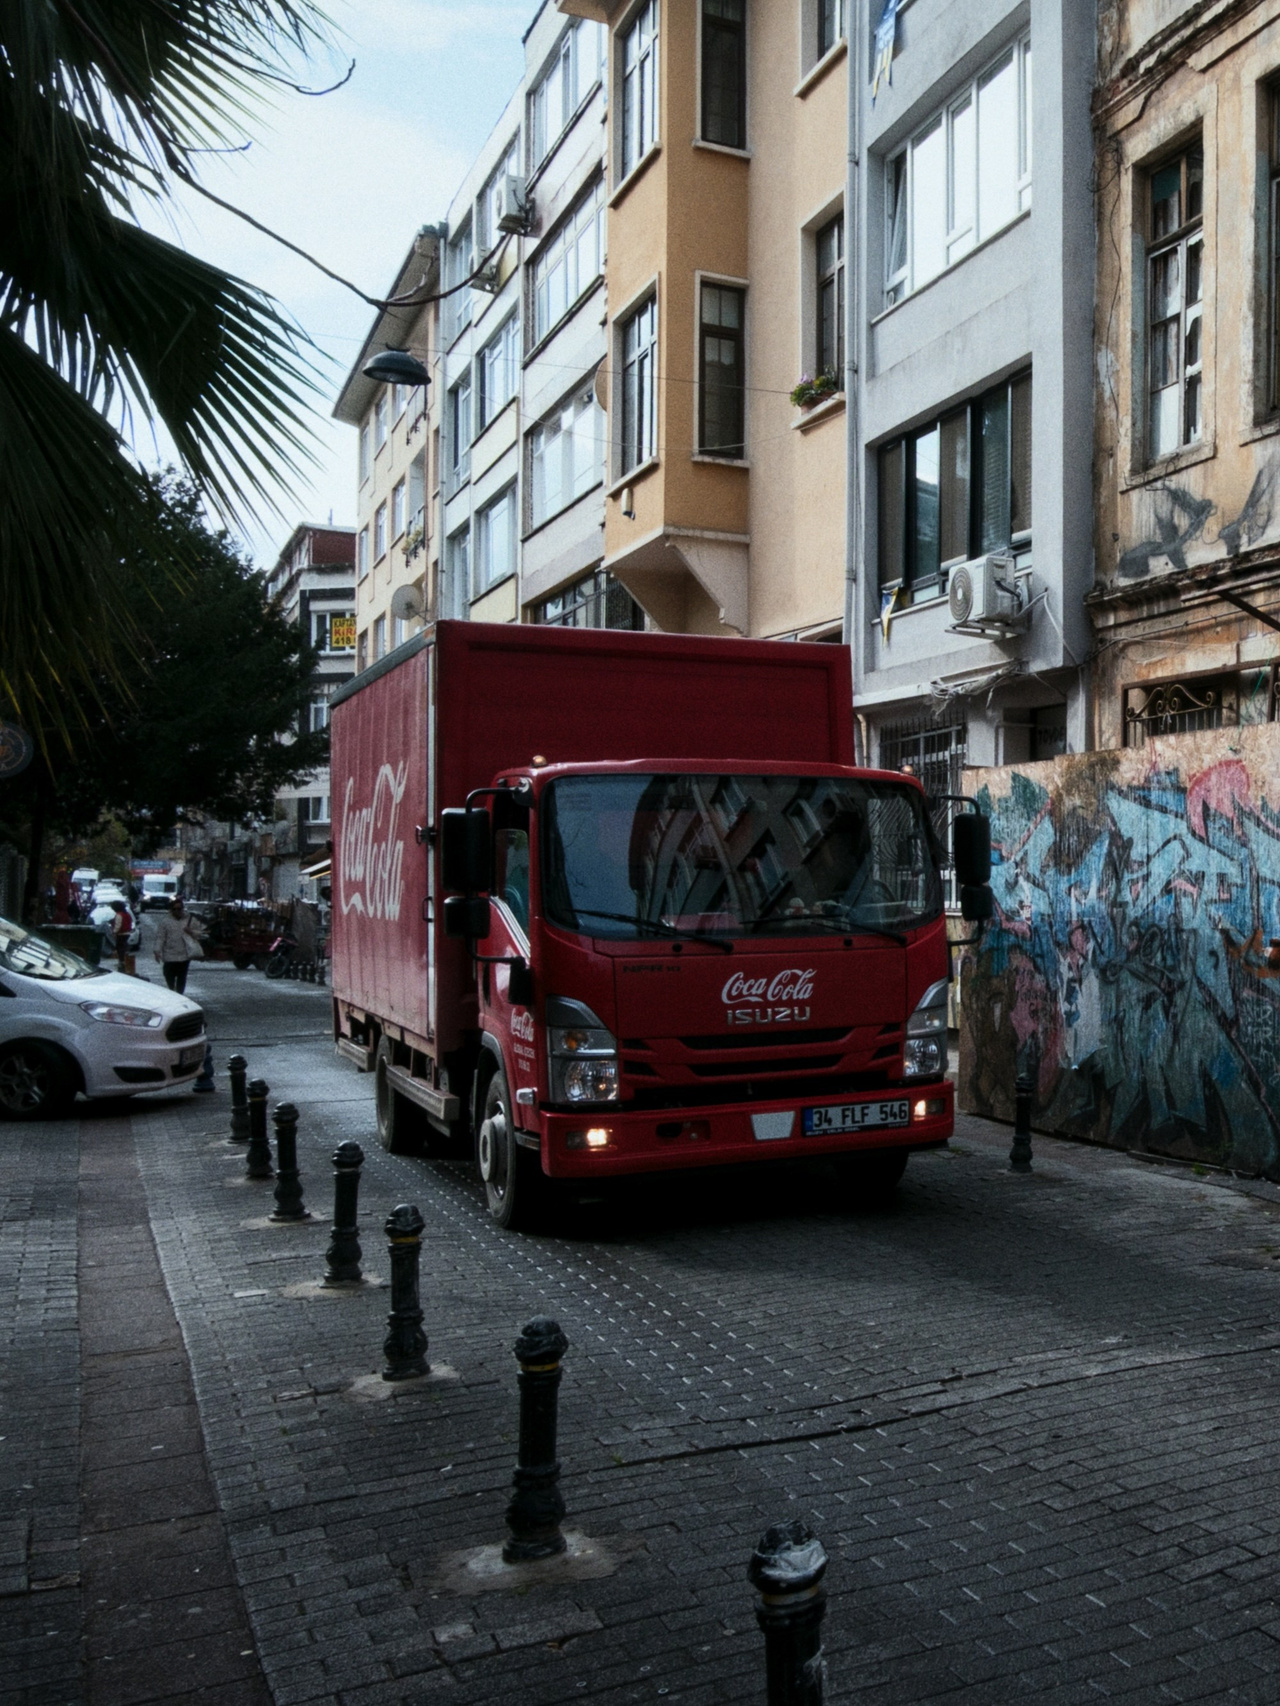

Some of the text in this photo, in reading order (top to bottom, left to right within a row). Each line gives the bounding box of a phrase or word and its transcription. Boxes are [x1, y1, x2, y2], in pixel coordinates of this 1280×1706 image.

[727, 1006, 810, 1025] ISUZU
[814, 1109, 832, 1128] 34
[841, 1106, 870, 1125] FLF
[879, 1103, 908, 1122] 546
